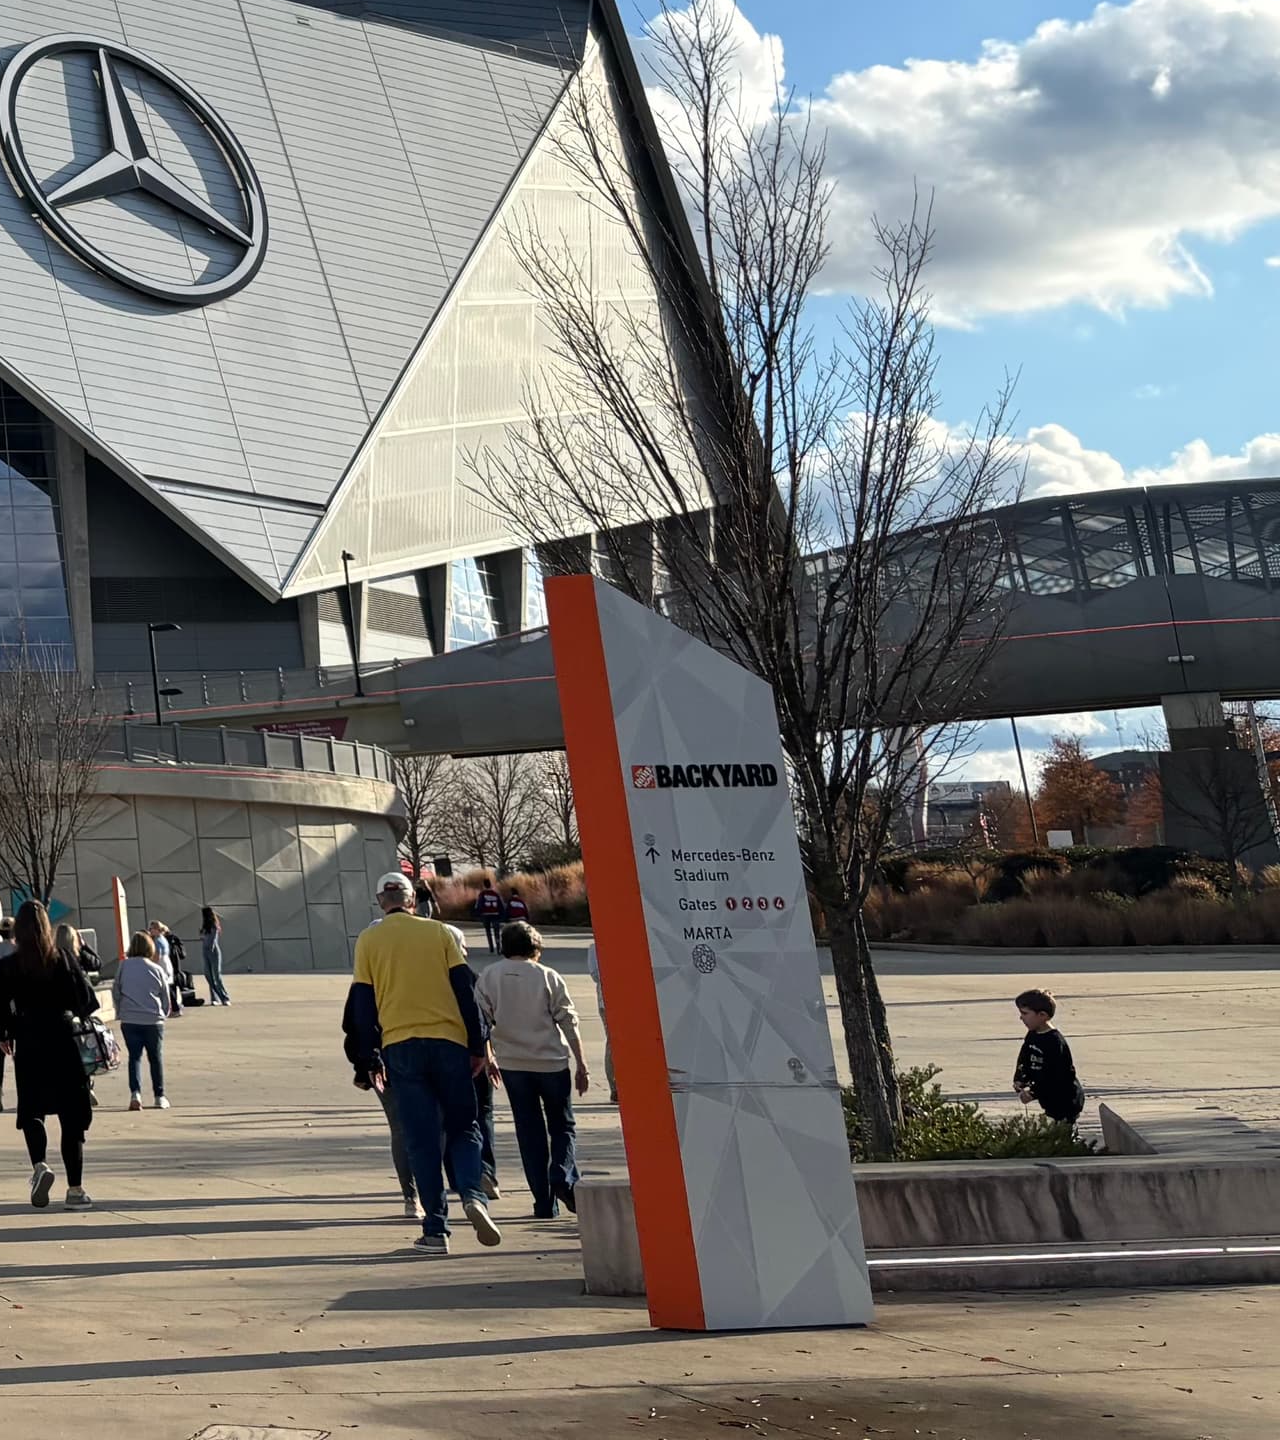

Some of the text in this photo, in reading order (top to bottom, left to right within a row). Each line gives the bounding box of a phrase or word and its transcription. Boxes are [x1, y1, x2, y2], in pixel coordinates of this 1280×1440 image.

[655, 763, 778, 788] BACKYARD
[671, 848, 775, 862] Mercedes-Benz
[673, 868, 729, 882] Stadium
[678, 897, 717, 911] Gates
[683, 926, 733, 940] MARTA
